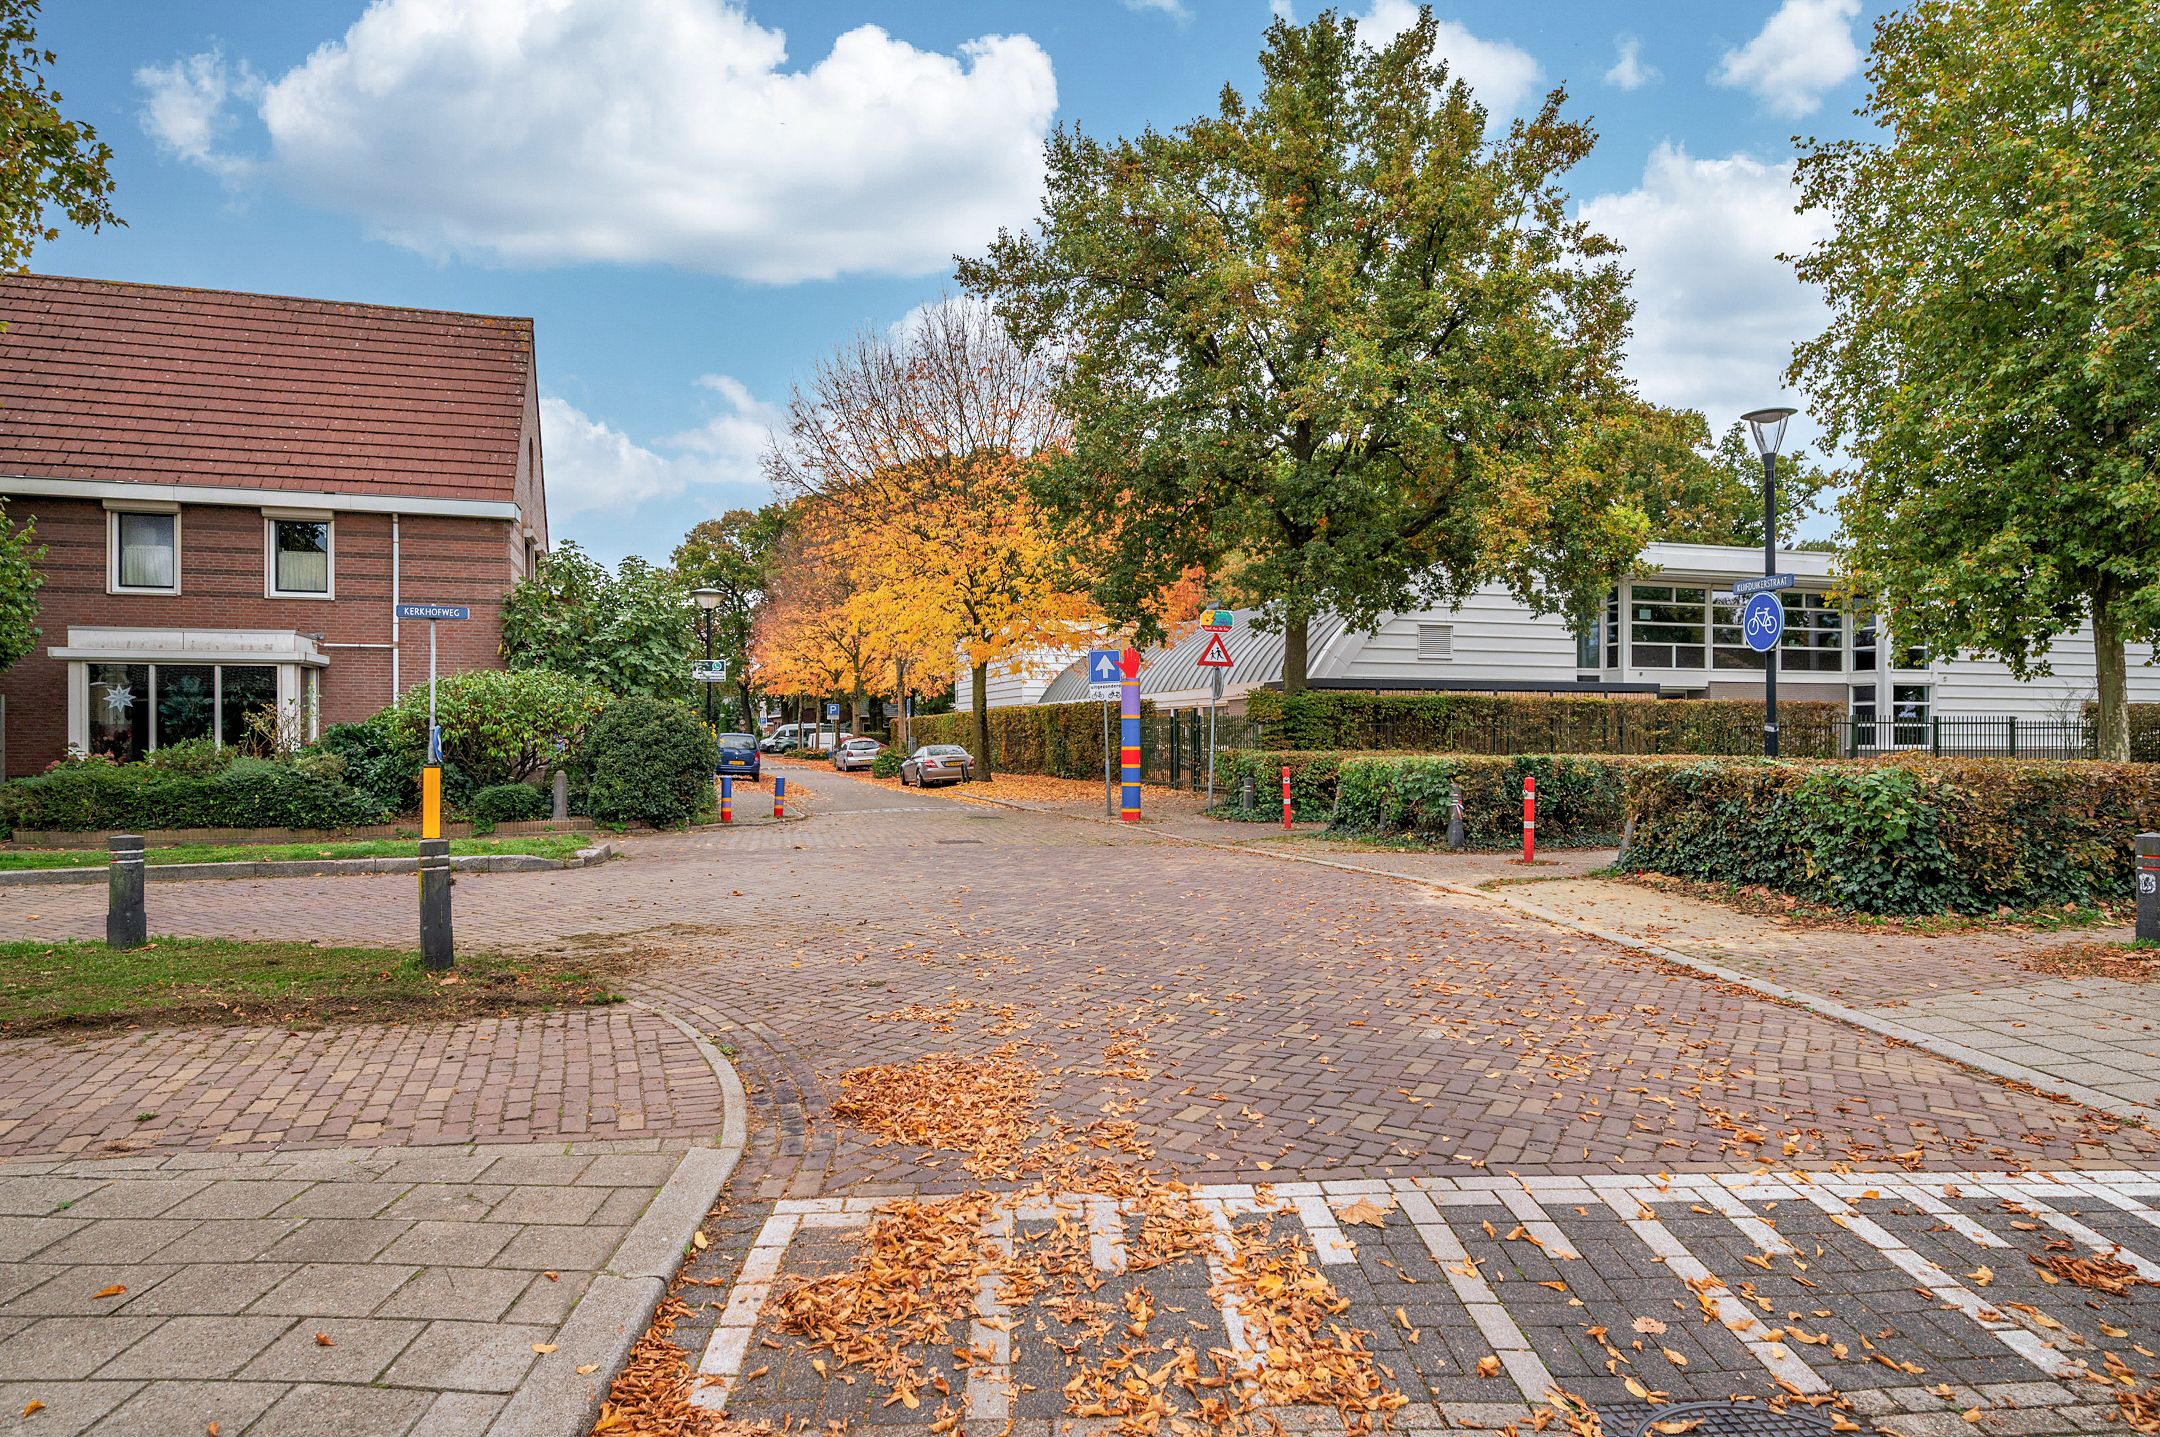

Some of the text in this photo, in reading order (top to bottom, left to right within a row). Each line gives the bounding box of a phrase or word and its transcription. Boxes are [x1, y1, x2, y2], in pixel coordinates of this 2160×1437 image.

[1736, 576, 1788, 592] KUIFDUIKERSTRAAT
[404, 607, 460, 617] KERKHOFWEG
[830, 705, 837, 714] P
